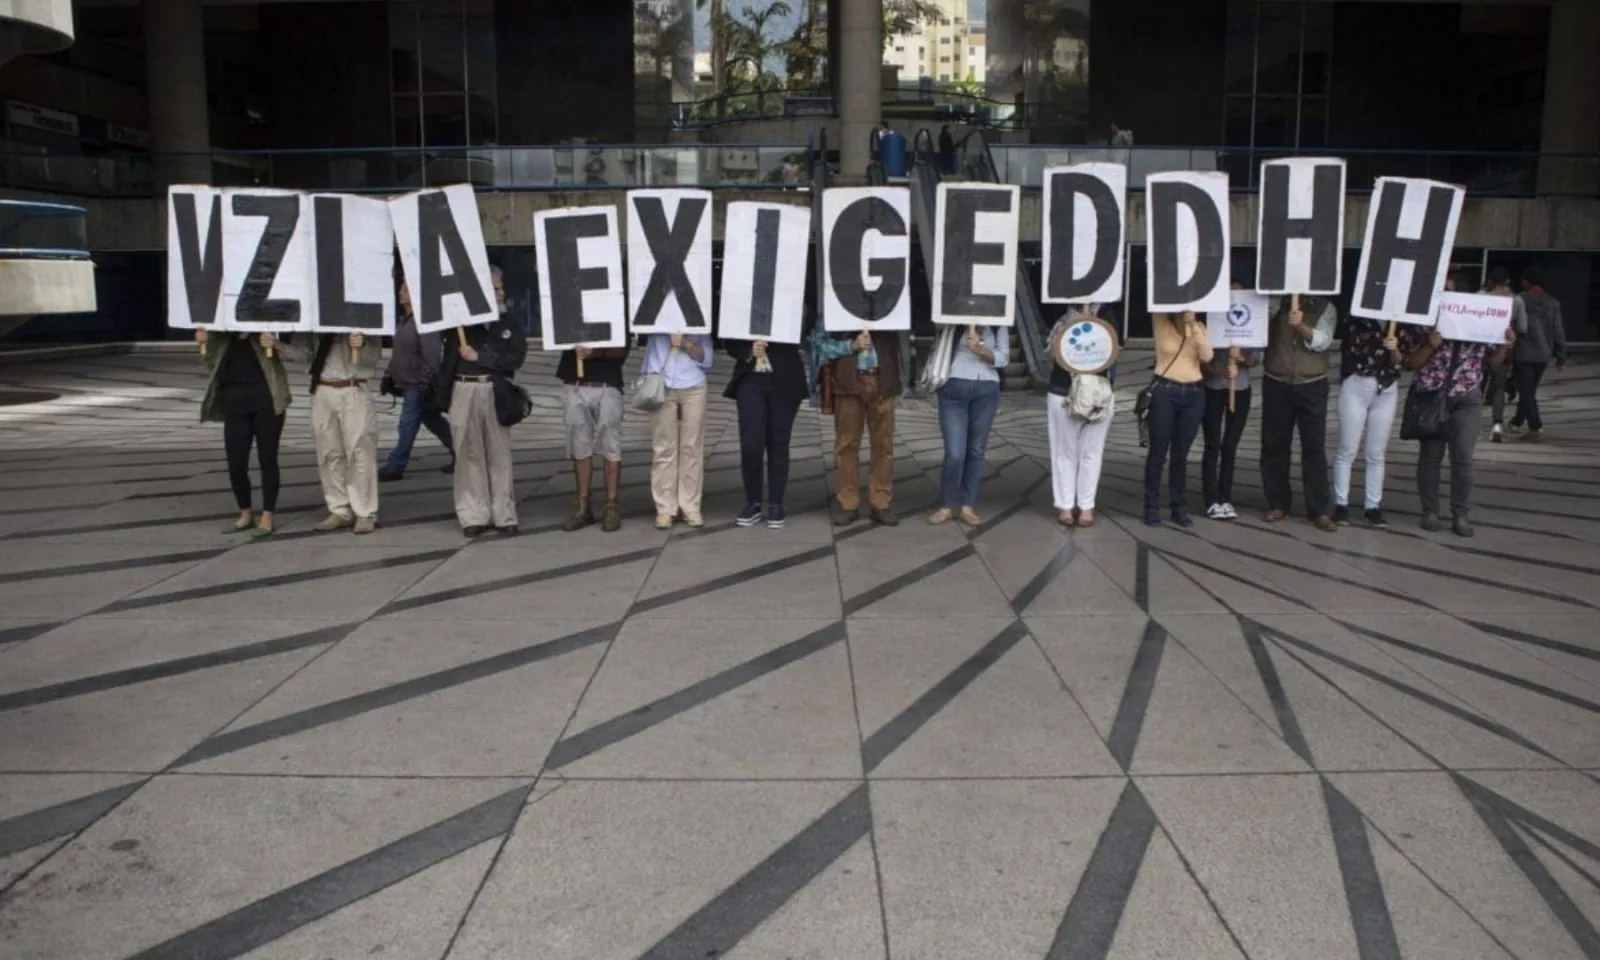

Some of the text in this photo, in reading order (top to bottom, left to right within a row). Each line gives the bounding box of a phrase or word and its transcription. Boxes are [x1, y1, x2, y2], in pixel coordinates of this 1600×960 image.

[172, 163, 1456, 345] VZLA EXIGE DDHH
